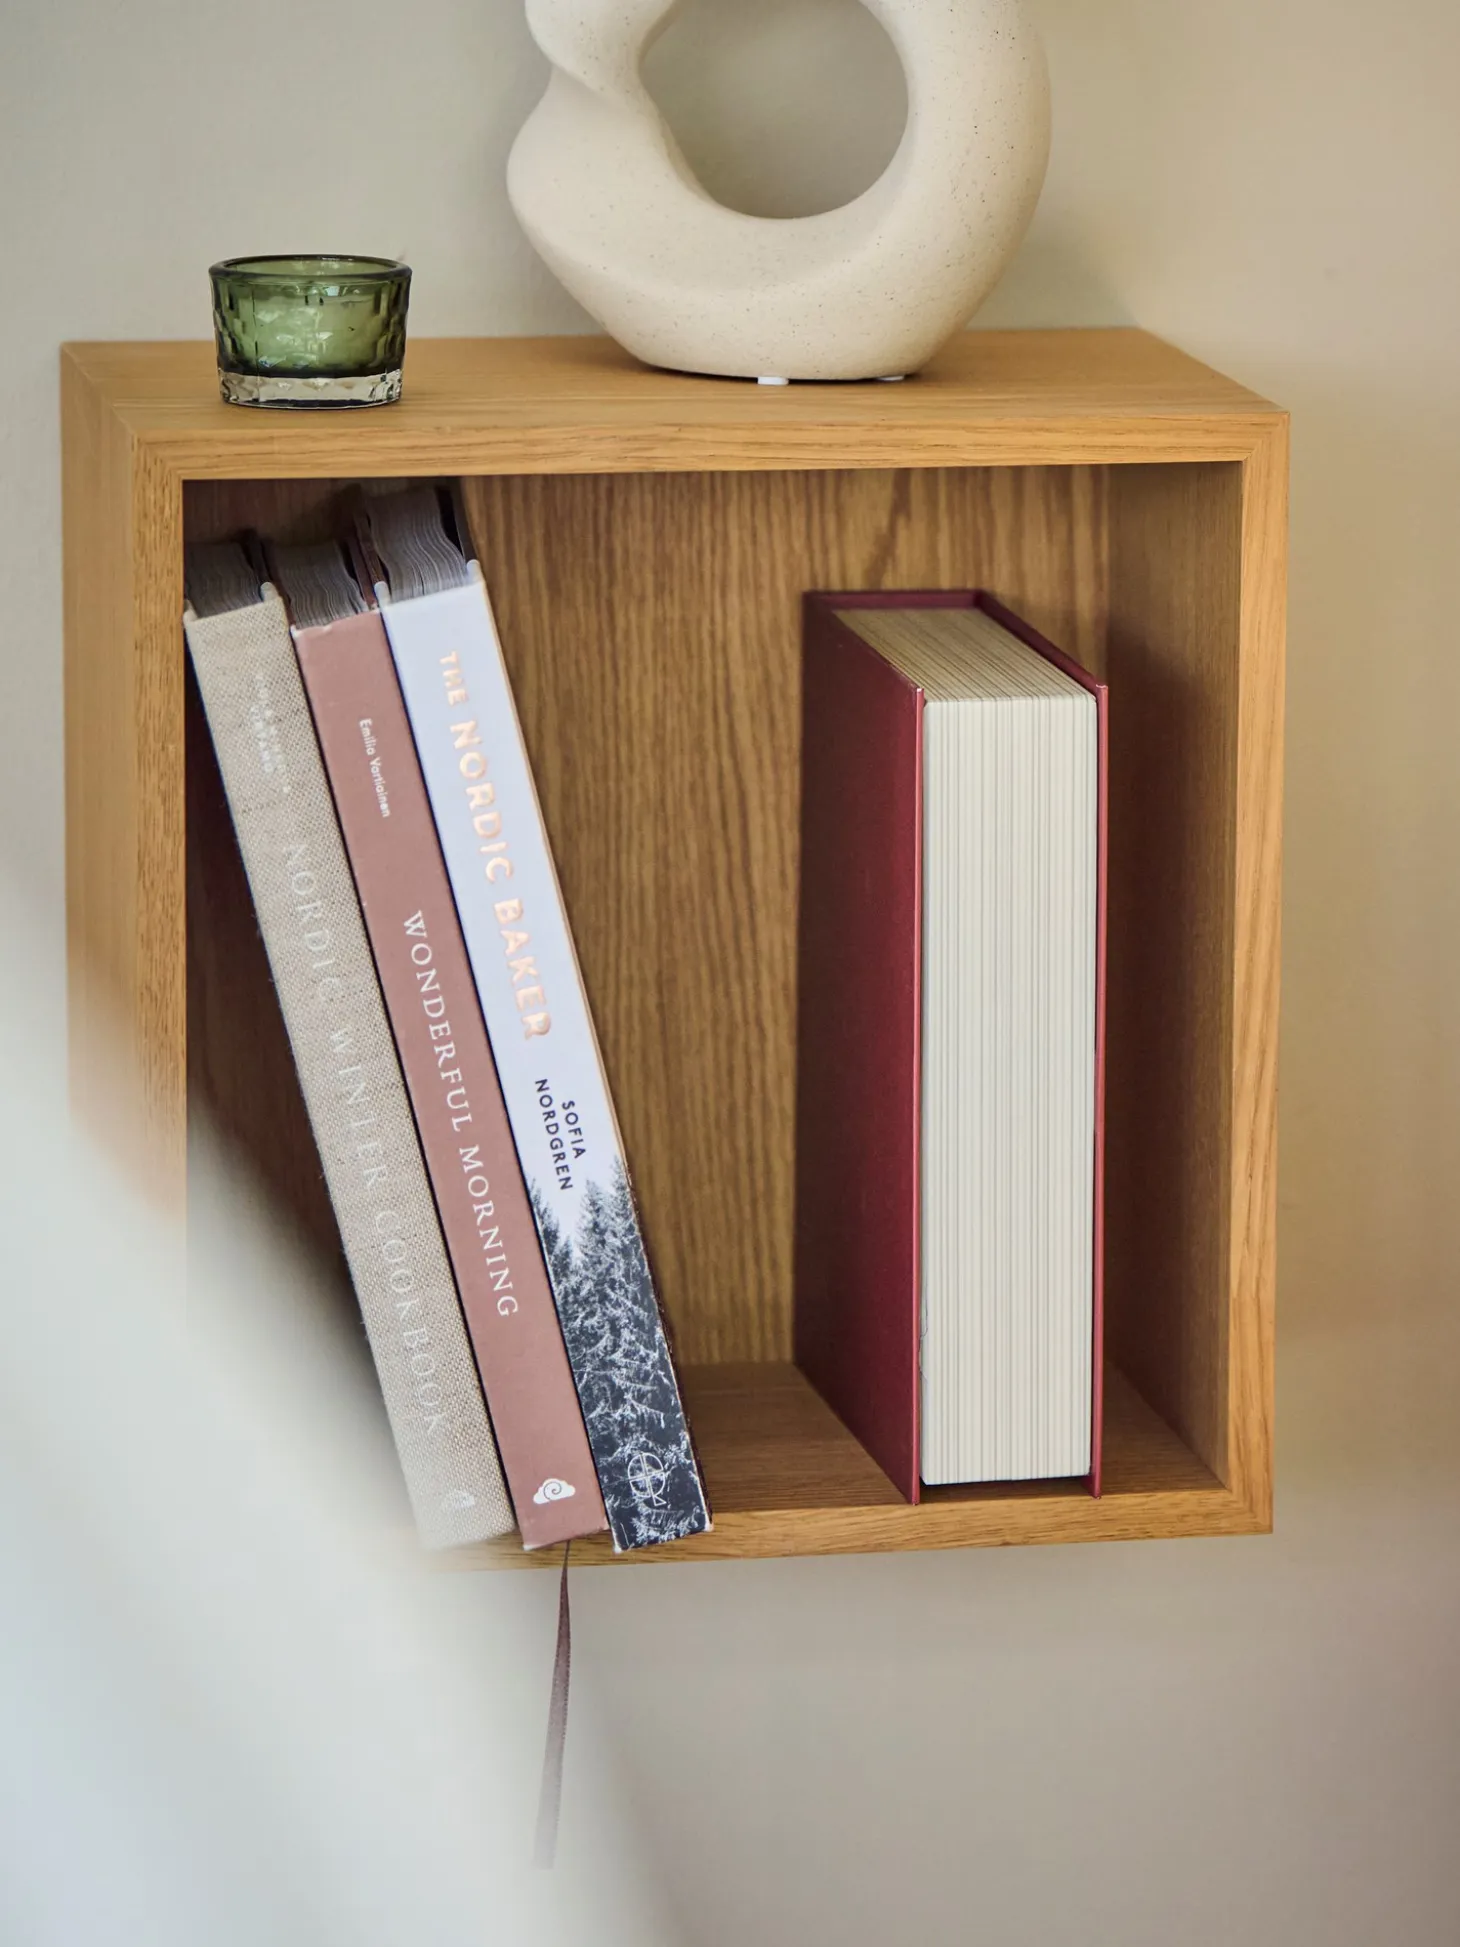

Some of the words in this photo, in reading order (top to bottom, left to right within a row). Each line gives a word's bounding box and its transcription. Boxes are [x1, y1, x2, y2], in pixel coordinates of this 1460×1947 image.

[440, 651, 469, 706] THE
[359, 718, 375, 756] Emilia
[370, 756, 390, 818] Vartiainen
[450, 720, 514, 882] NORDIC
[494, 898, 552, 1041] BAKER
[284, 841, 344, 997] NORDIC
[330, 1028, 390, 1188] WINTER
[374, 1208, 447, 1433] COOKBOOK
[403, 909, 475, 1131] WONDERFUL
[459, 1145, 519, 1318] MORNING
[535, 1078, 573, 1191] NORDGREN
[562, 1100, 586, 1160] SOFIA
